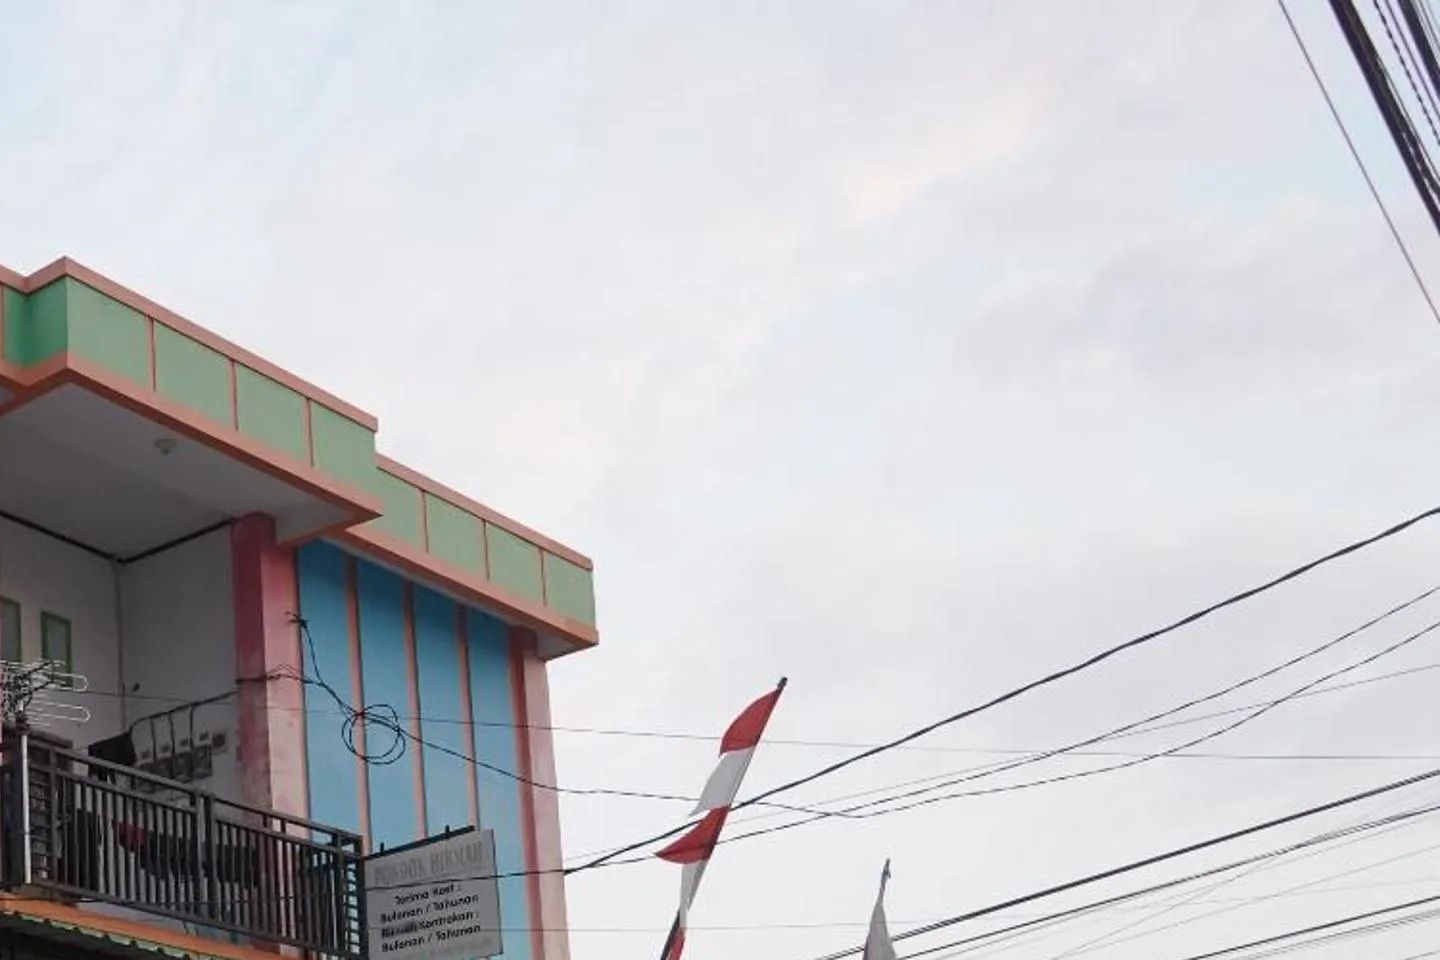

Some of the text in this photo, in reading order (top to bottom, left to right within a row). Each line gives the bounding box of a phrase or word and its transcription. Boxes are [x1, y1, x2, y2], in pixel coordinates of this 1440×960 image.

[380, 907, 423, 923] Bulanan
[433, 894, 479, 911] Tahunan
[381, 936, 425, 952] Bulanan
[436, 924, 481, 941] Tahunan
